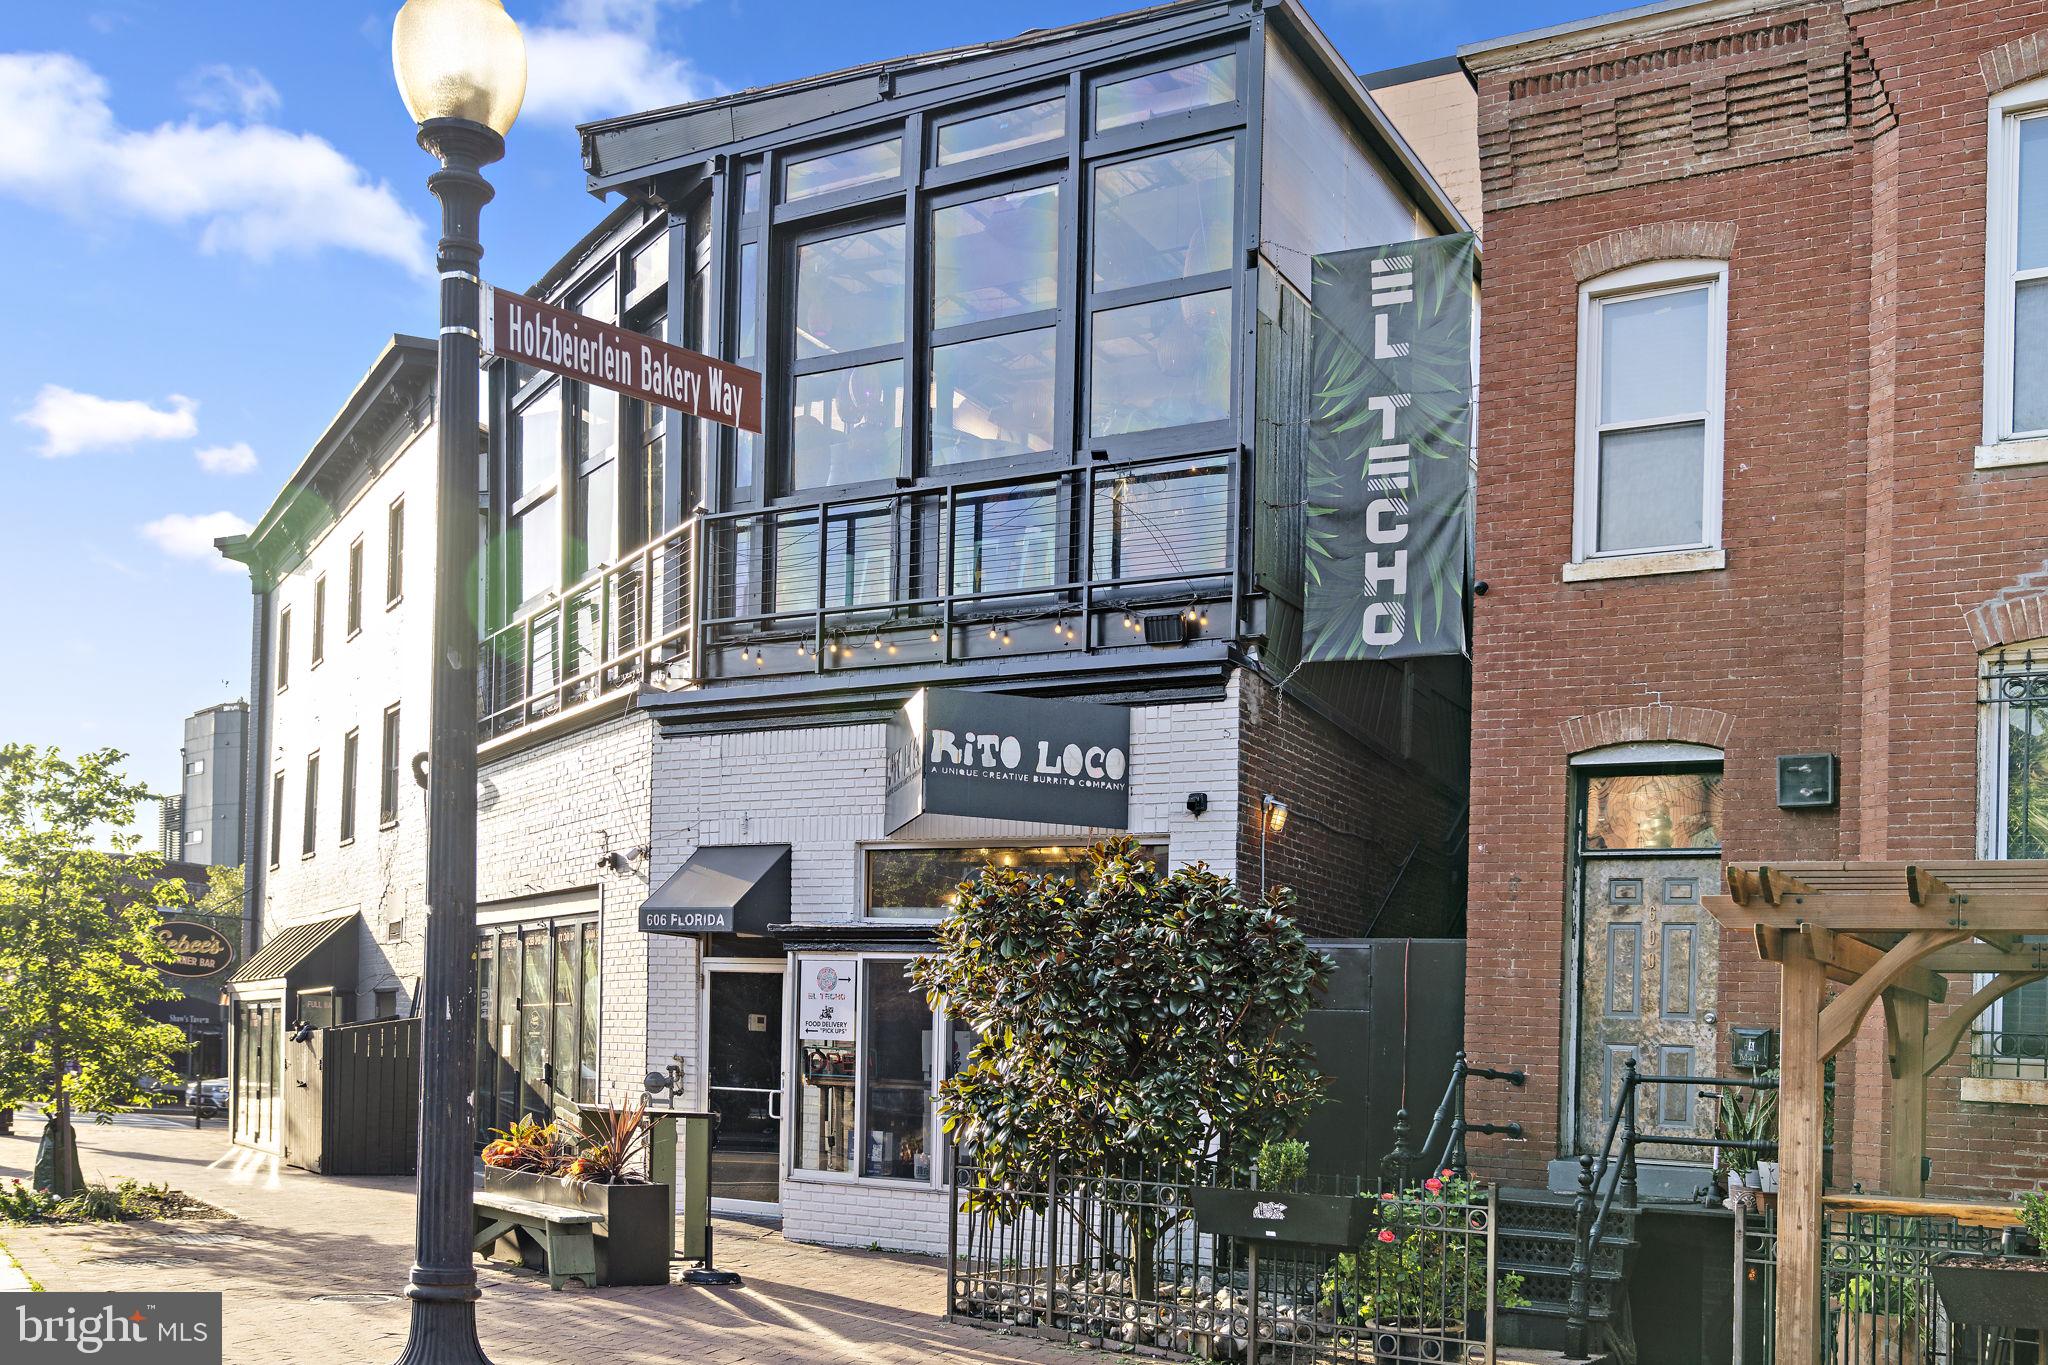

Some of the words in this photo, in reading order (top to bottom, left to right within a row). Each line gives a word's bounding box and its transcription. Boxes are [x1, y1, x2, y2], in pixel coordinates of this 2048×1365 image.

[1371, 255, 1413, 359] EL
[509, 303, 632, 386] Holzbeierlein
[641, 344, 701, 415] Bakery
[708, 366, 743, 427] Way
[1363, 393, 1411, 646] TECHO
[1036, 740, 1126, 780] LOCO
[941, 767, 979, 777] UNIQUE
[982, 770, 1029, 782] CREATIVE
[1033, 774, 1075, 786] BURRITO
[1078, 779, 1126, 791] COMPANY
[646, 914, 667, 926] 606
[670, 913, 725, 926] FLORIDA
[200, 958, 215, 968] BAR
[805, 1020, 821, 1028] FOOD
[822, 1021, 848, 1029] DELIVERY
[1739, 1054, 1760, 1062] Mail
